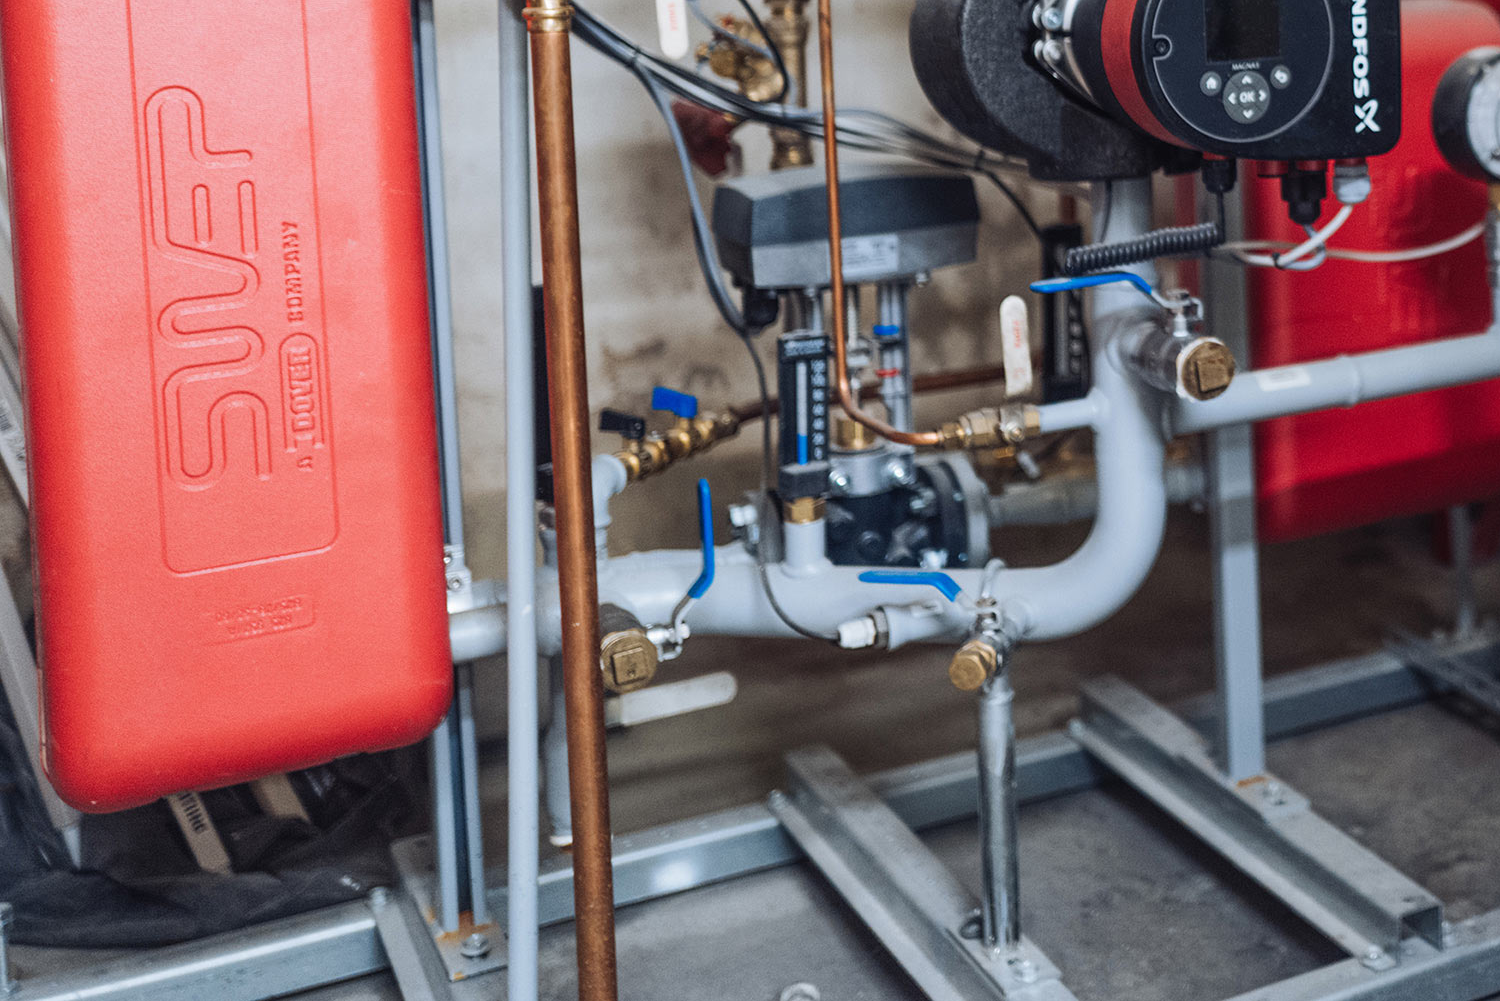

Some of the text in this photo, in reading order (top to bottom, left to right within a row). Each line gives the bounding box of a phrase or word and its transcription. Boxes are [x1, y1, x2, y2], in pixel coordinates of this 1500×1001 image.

[1239, 90, 1256, 104] OK
[144, 85, 272, 491] SWEP
[281, 220, 303, 325] COMPANY
[287, 347, 315, 434] DOVER
